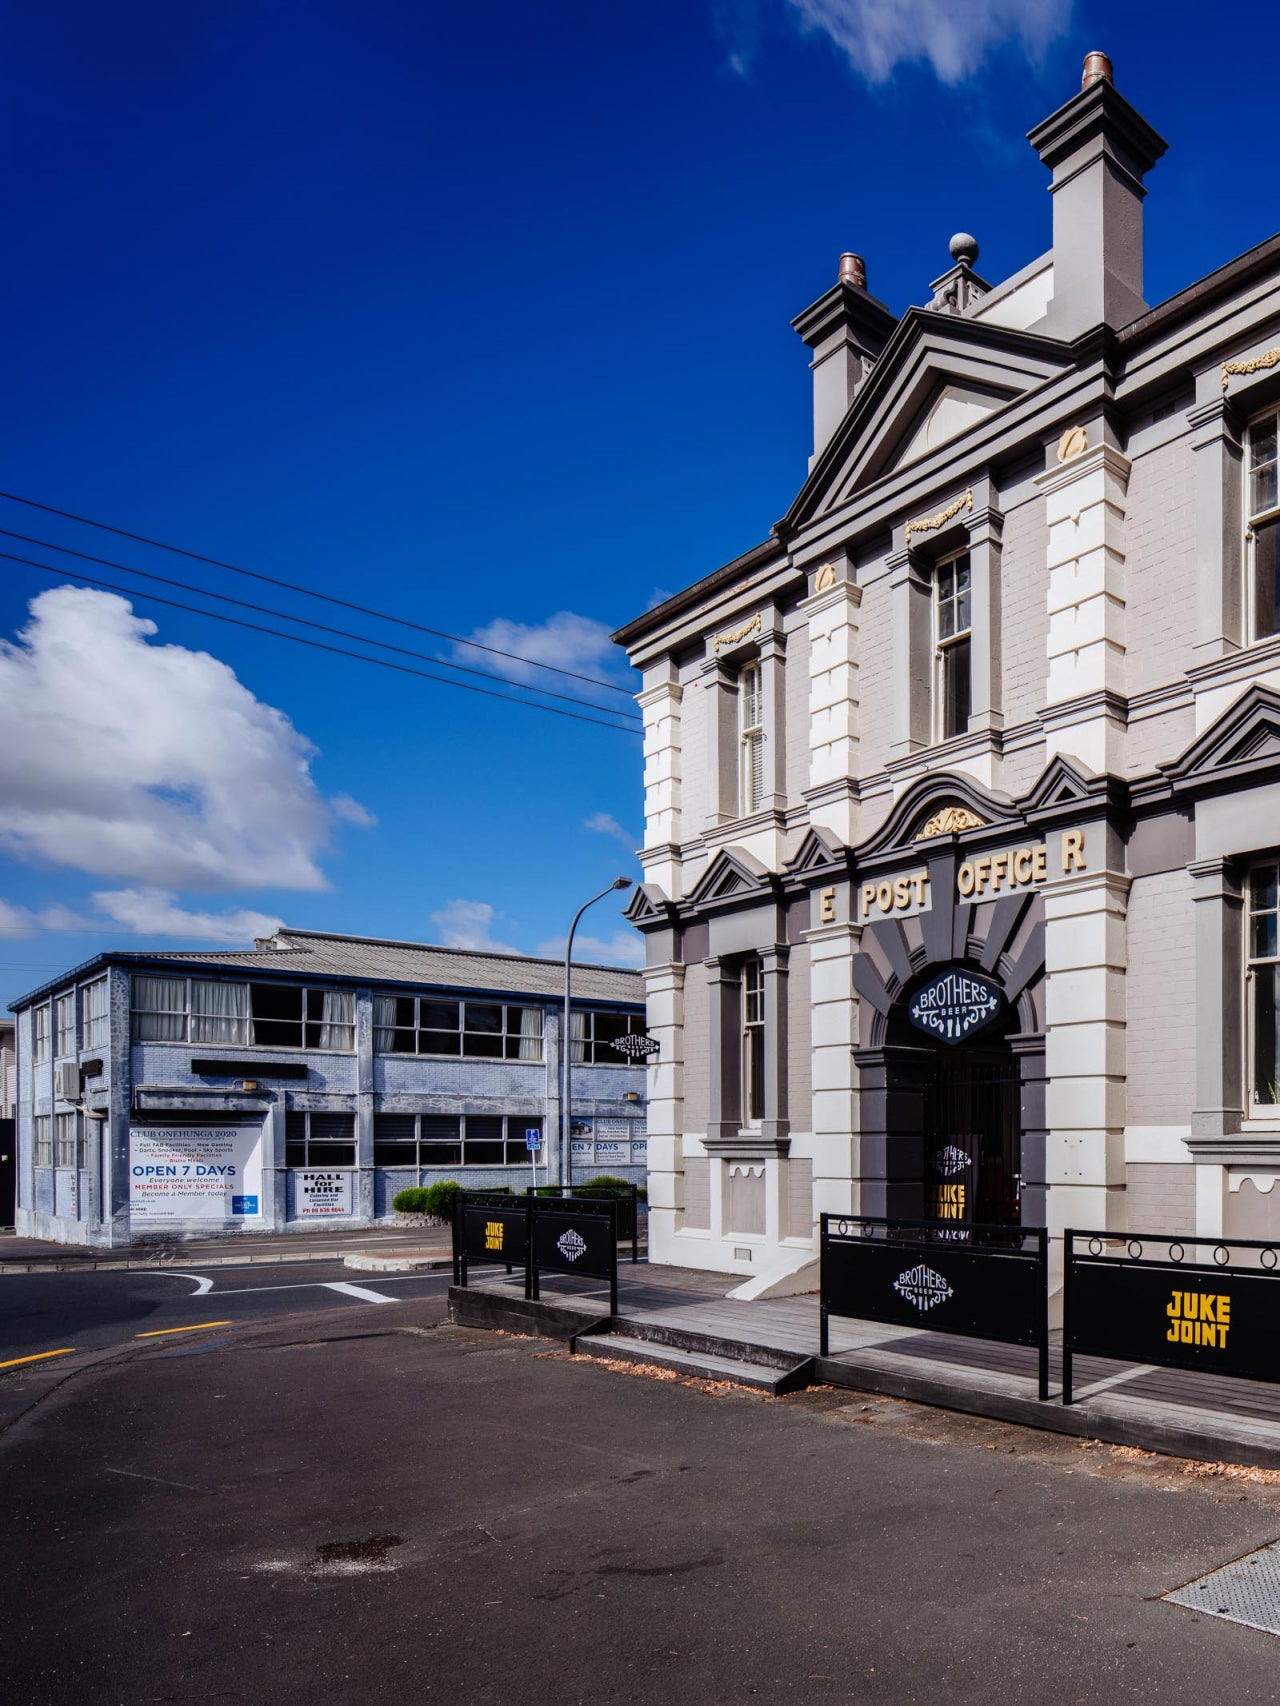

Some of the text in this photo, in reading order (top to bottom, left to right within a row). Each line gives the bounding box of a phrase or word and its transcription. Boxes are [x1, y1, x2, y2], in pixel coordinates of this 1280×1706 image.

[820, 830, 1086, 922] E POST OFFICE R
[920, 974, 987, 1008] BROTHERS
[942, 1006, 966, 1015] BEER
[614, 1034, 654, 1046] BROTHERS
[132, 1166, 236, 1176] OPEN 7 DAYS
[486, 1222, 504, 1237] JUKE
[560, 1229, 584, 1246] BROTHERS
[486, 1236, 503, 1250] JOINT
[900, 1264, 947, 1289] BROTHERS
[1167, 1291, 1230, 1323] JUKE
[1167, 1319, 1229, 1349] JOINT
